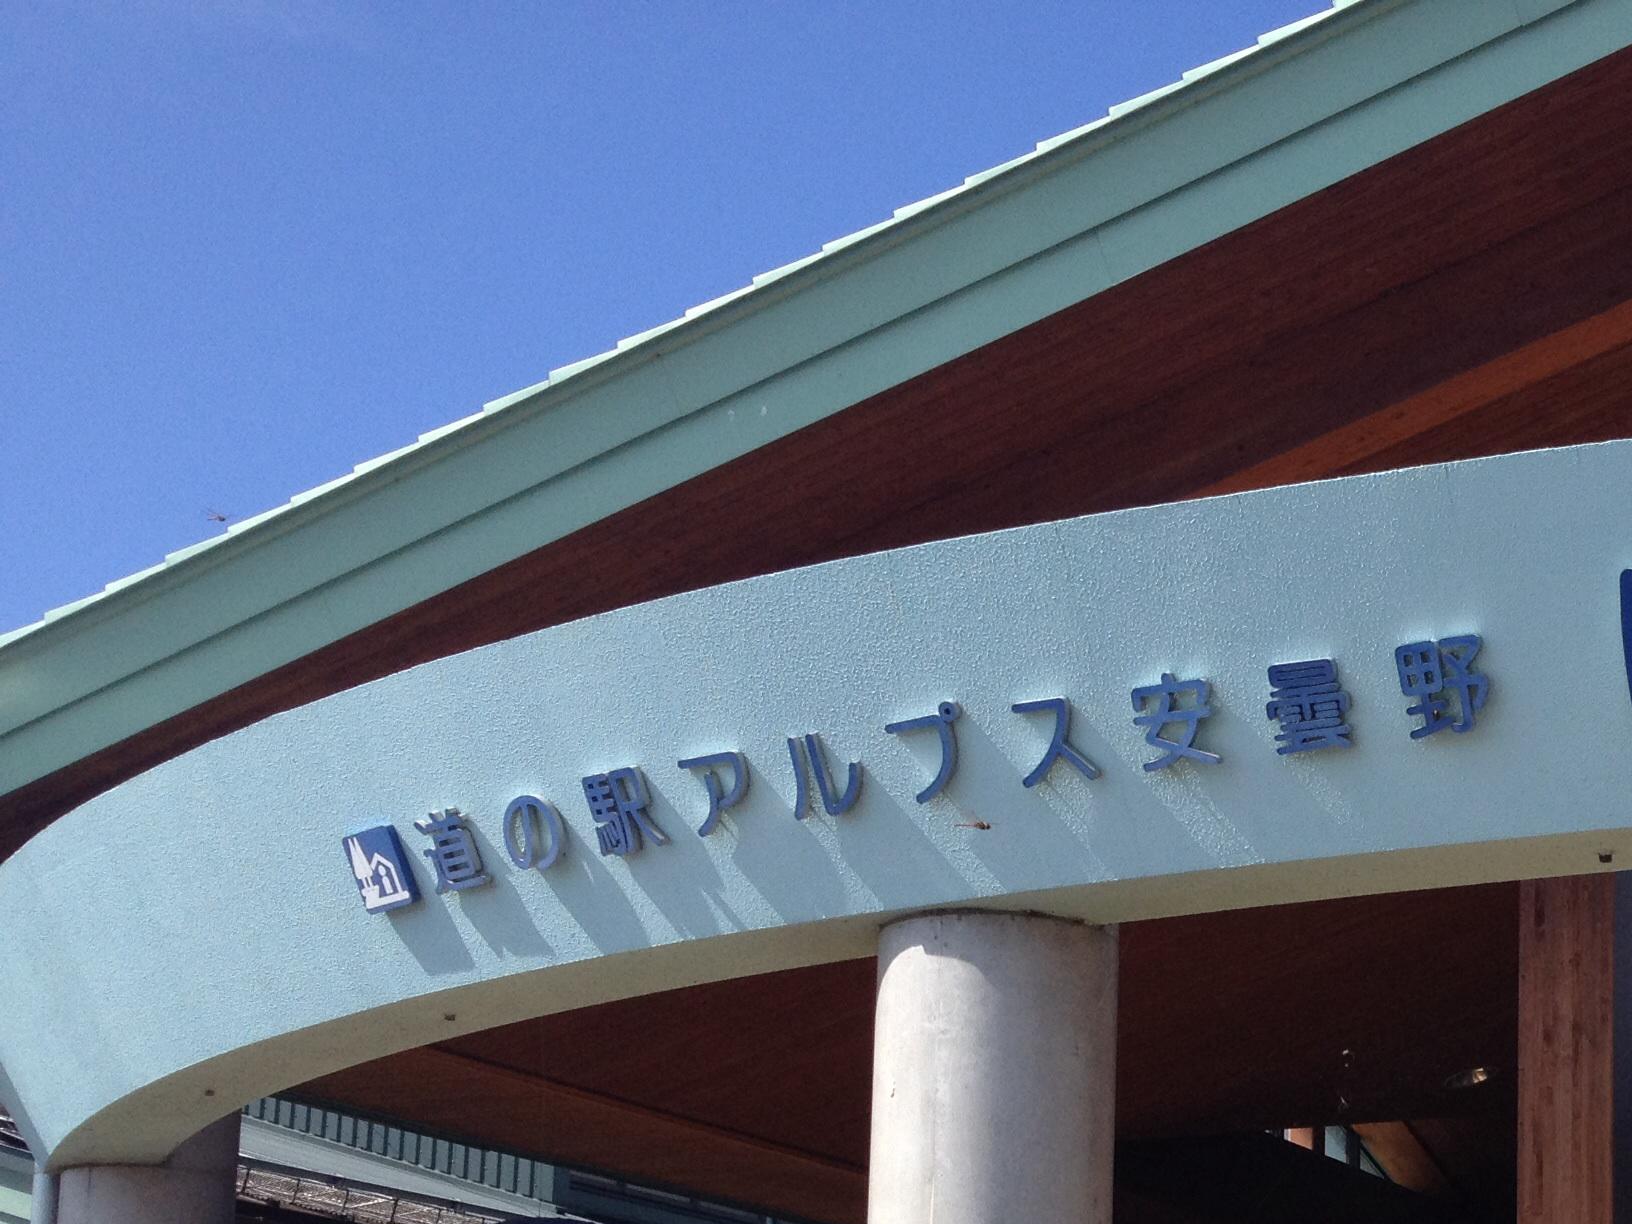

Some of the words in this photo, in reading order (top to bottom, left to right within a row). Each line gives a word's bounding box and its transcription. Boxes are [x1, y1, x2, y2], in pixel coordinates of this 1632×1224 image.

[413, 633, 1490, 893] 道の駅アルプス安曇野
